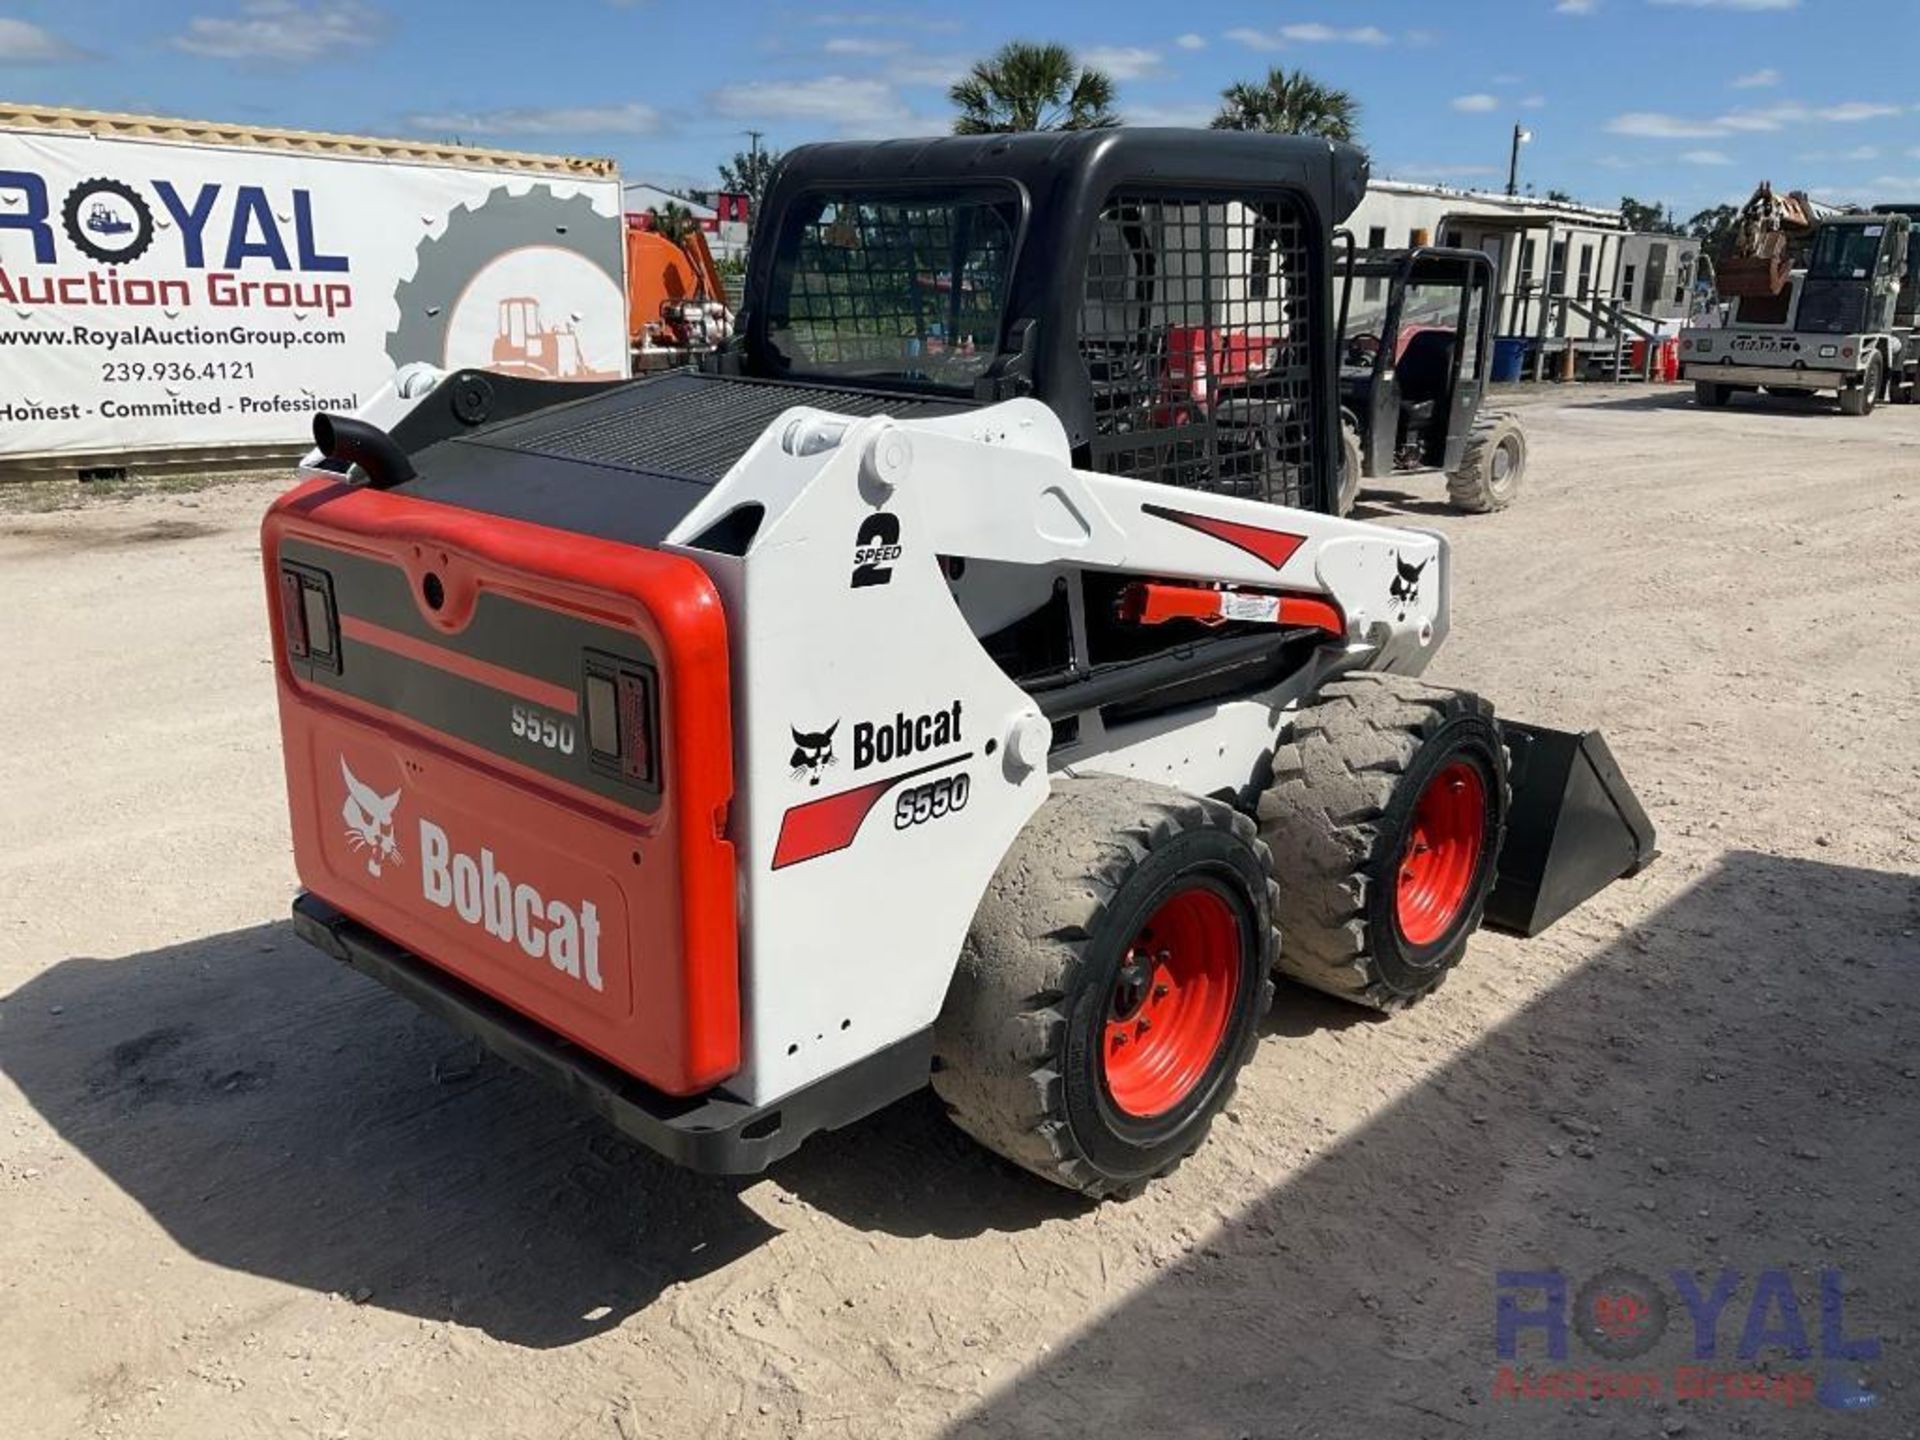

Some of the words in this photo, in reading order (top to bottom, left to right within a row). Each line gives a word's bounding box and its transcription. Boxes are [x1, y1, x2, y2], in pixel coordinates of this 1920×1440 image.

[0, 267, 190, 307] Auction
[207, 273, 351, 317] Group
[0, 325, 346, 350] www.RoyalAuctionGroup.com
[101, 361, 254, 382] 239.936.4121
[0, 403, 80, 421] Honest
[100, 397, 222, 418] Committed
[240, 393, 358, 413] Professional
[850, 512, 900, 588] 2
[854, 545, 902, 564] SPEED
[511, 703, 575, 755] S550
[853, 699, 962, 770] Bobcat
[894, 772, 970, 831] S550
[419, 818, 604, 993] Bobcat
